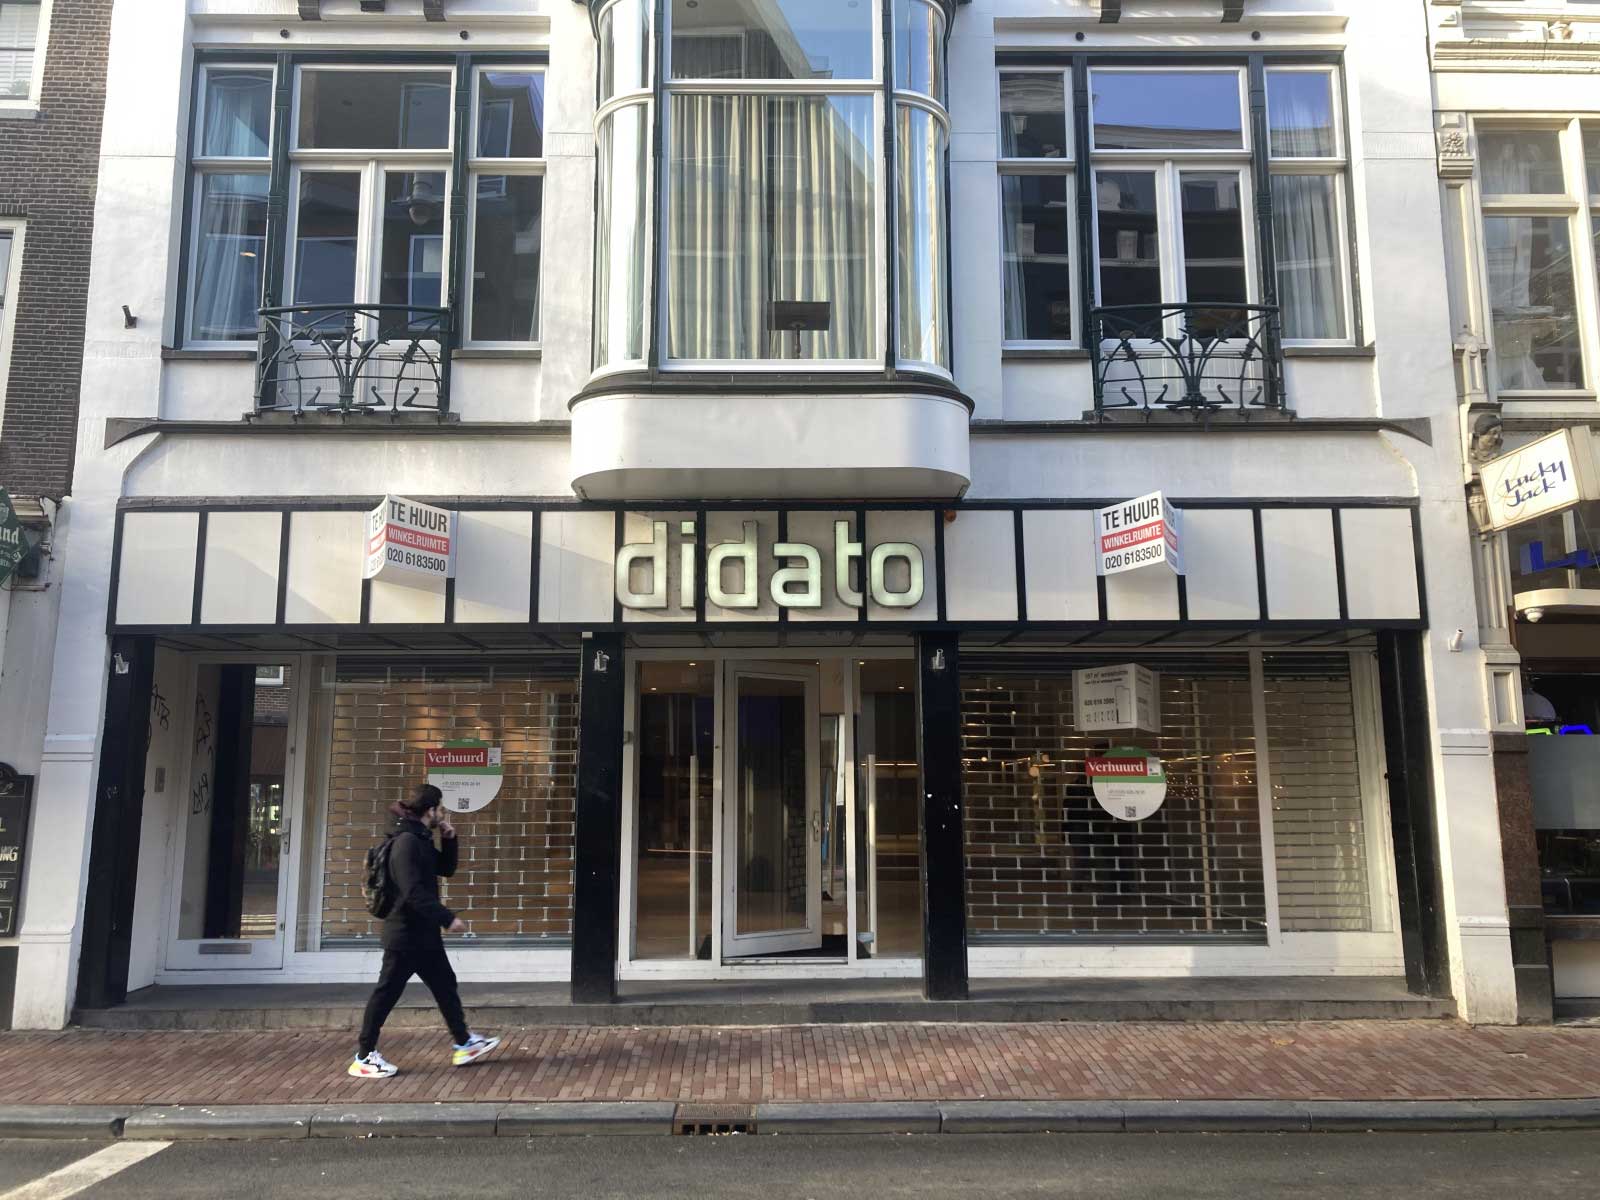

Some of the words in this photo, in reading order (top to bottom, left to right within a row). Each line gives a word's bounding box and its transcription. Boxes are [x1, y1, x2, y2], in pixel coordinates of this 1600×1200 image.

[1505, 460, 1567, 494] Lucky
[1507, 478, 1556, 507] Jack
[389, 499, 406, 523] TE
[409, 505, 448, 533] HUUR
[1102, 509, 1120, 530] TE
[1123, 497, 1160, 526] HUUR
[388, 527, 448, 552] WINKELRUIMTE
[1103, 524, 1162, 550] WINKELRUIMTE
[387, 547, 404, 564] 020
[405, 552, 446, 572] 6183500
[615, 519, 925, 609] didato
[1105, 554, 1122, 570] 020
[1124, 544, 1162, 566] 6183500
[427, 751, 485, 763] Verhuurd
[1087, 760, 1145, 773] Verhuurd
